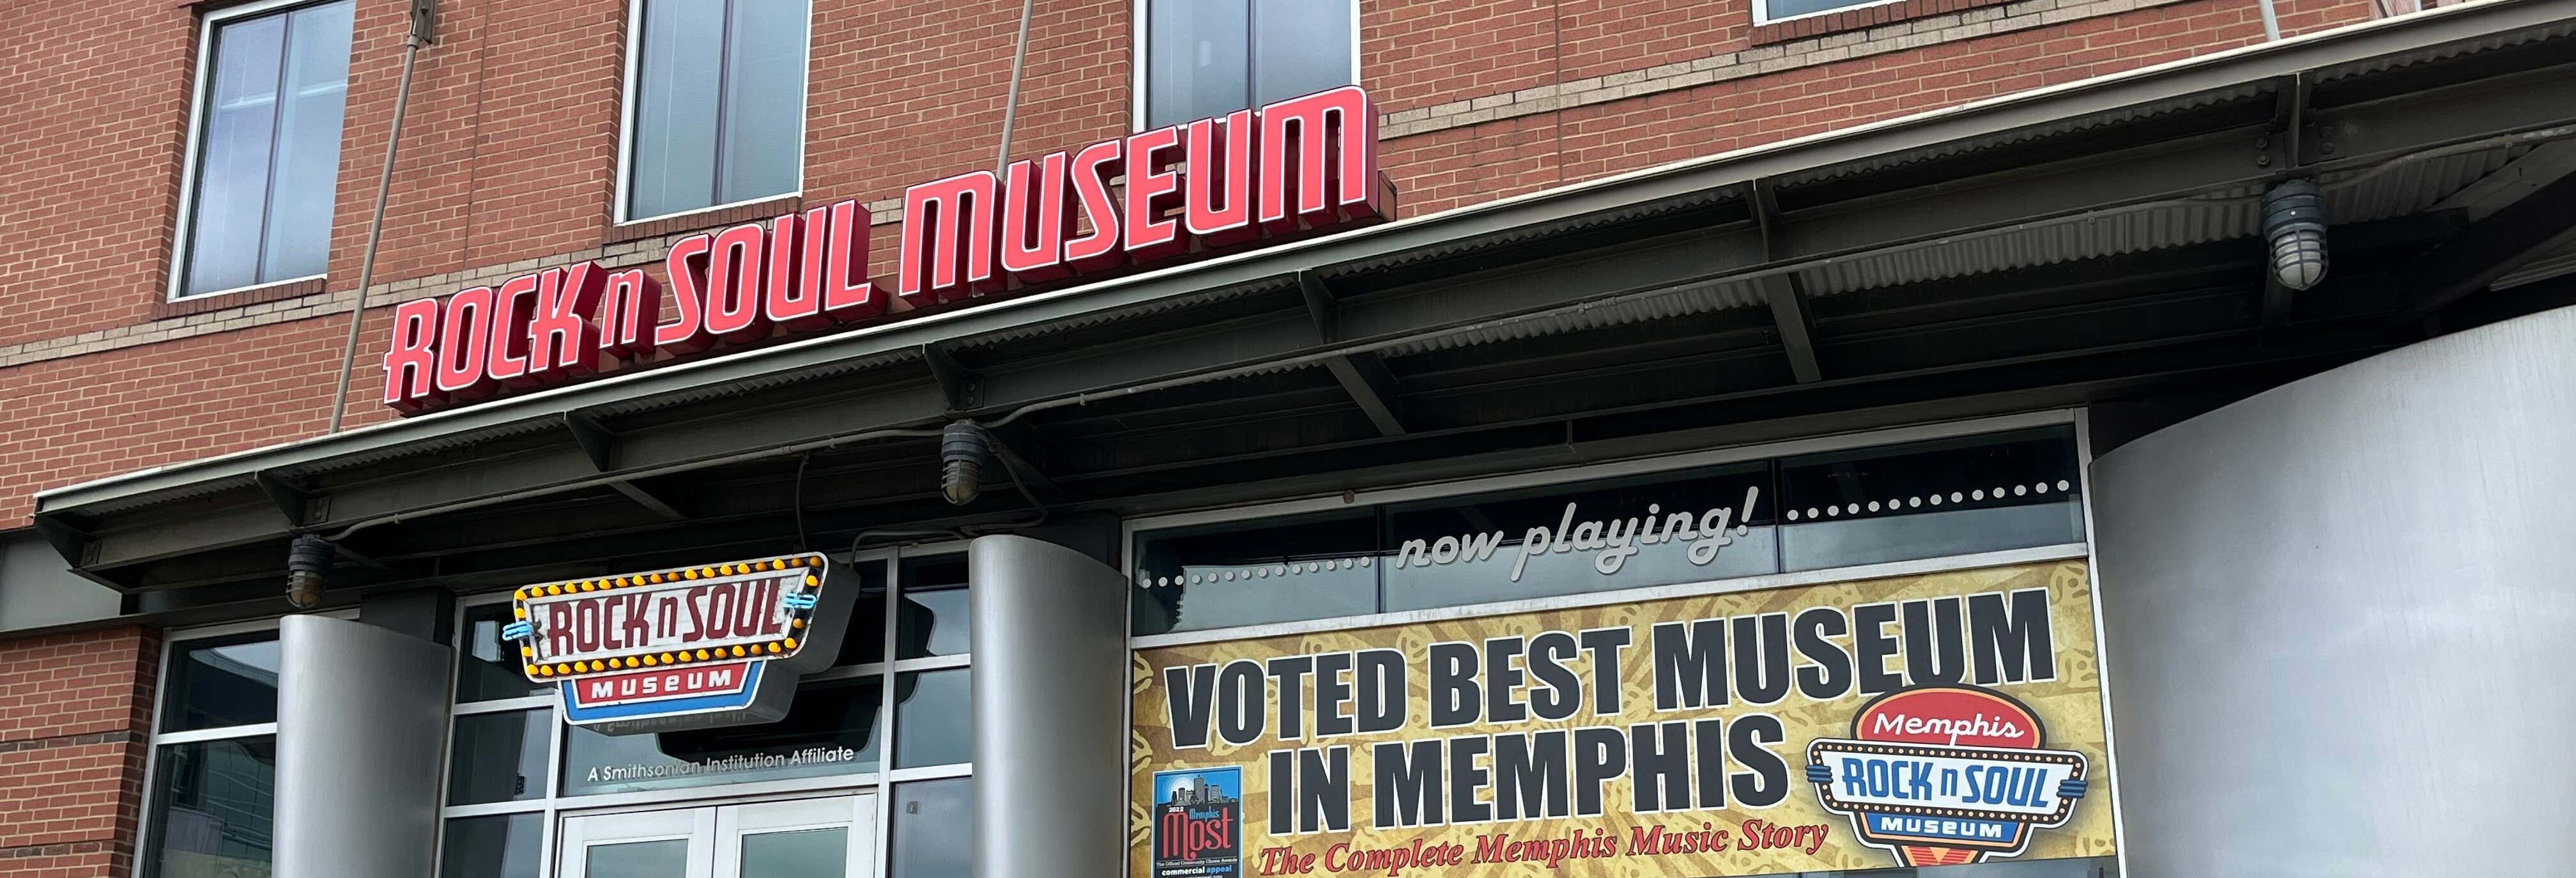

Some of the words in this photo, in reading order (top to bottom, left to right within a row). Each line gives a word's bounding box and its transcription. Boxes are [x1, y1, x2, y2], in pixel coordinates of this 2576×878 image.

[383, 260, 595, 405] ROCK
[600, 268, 644, 349] n
[654, 199, 871, 346] SOUL
[898, 84, 1367, 297] MUSEUM
[1395, 530, 1504, 569] now
[1510, 486, 1759, 582] playing!
[548, 592, 653, 656] ROCK
[657, 597, 678, 638] n
[682, 577, 783, 643] SOUL
[1163, 647, 1408, 749] VOTED
[1428, 625, 1632, 729] BEST
[1650, 586, 2057, 714] MUSEUM
[1873, 712, 2025, 746] Memphis
[586, 767, 599, 782] A
[602, 762, 701, 780] Smithsonian
[706, 753, 785, 773] Institution
[790, 746, 855, 766] Affiliate
[1267, 744, 1352, 837] IN
[1371, 712, 1791, 831] MEMPHIS
[1841, 757, 1934, 801] ROCK
[1940, 767, 1958, 797] n
[1962, 764, 2049, 808] SOUL
[1163, 807, 1234, 861] Most
[1189, 805, 1220, 822] Memphis
[1162, 866, 1205, 876] commercial
[1206, 865, 1232, 874] appeal
[1261, 845, 1317, 876] The
[1324, 837, 1464, 877] Complete
[1471, 827, 1618, 868] Memphis
[1625, 820, 1729, 858] Music
[1738, 817, 1830, 855] Story
